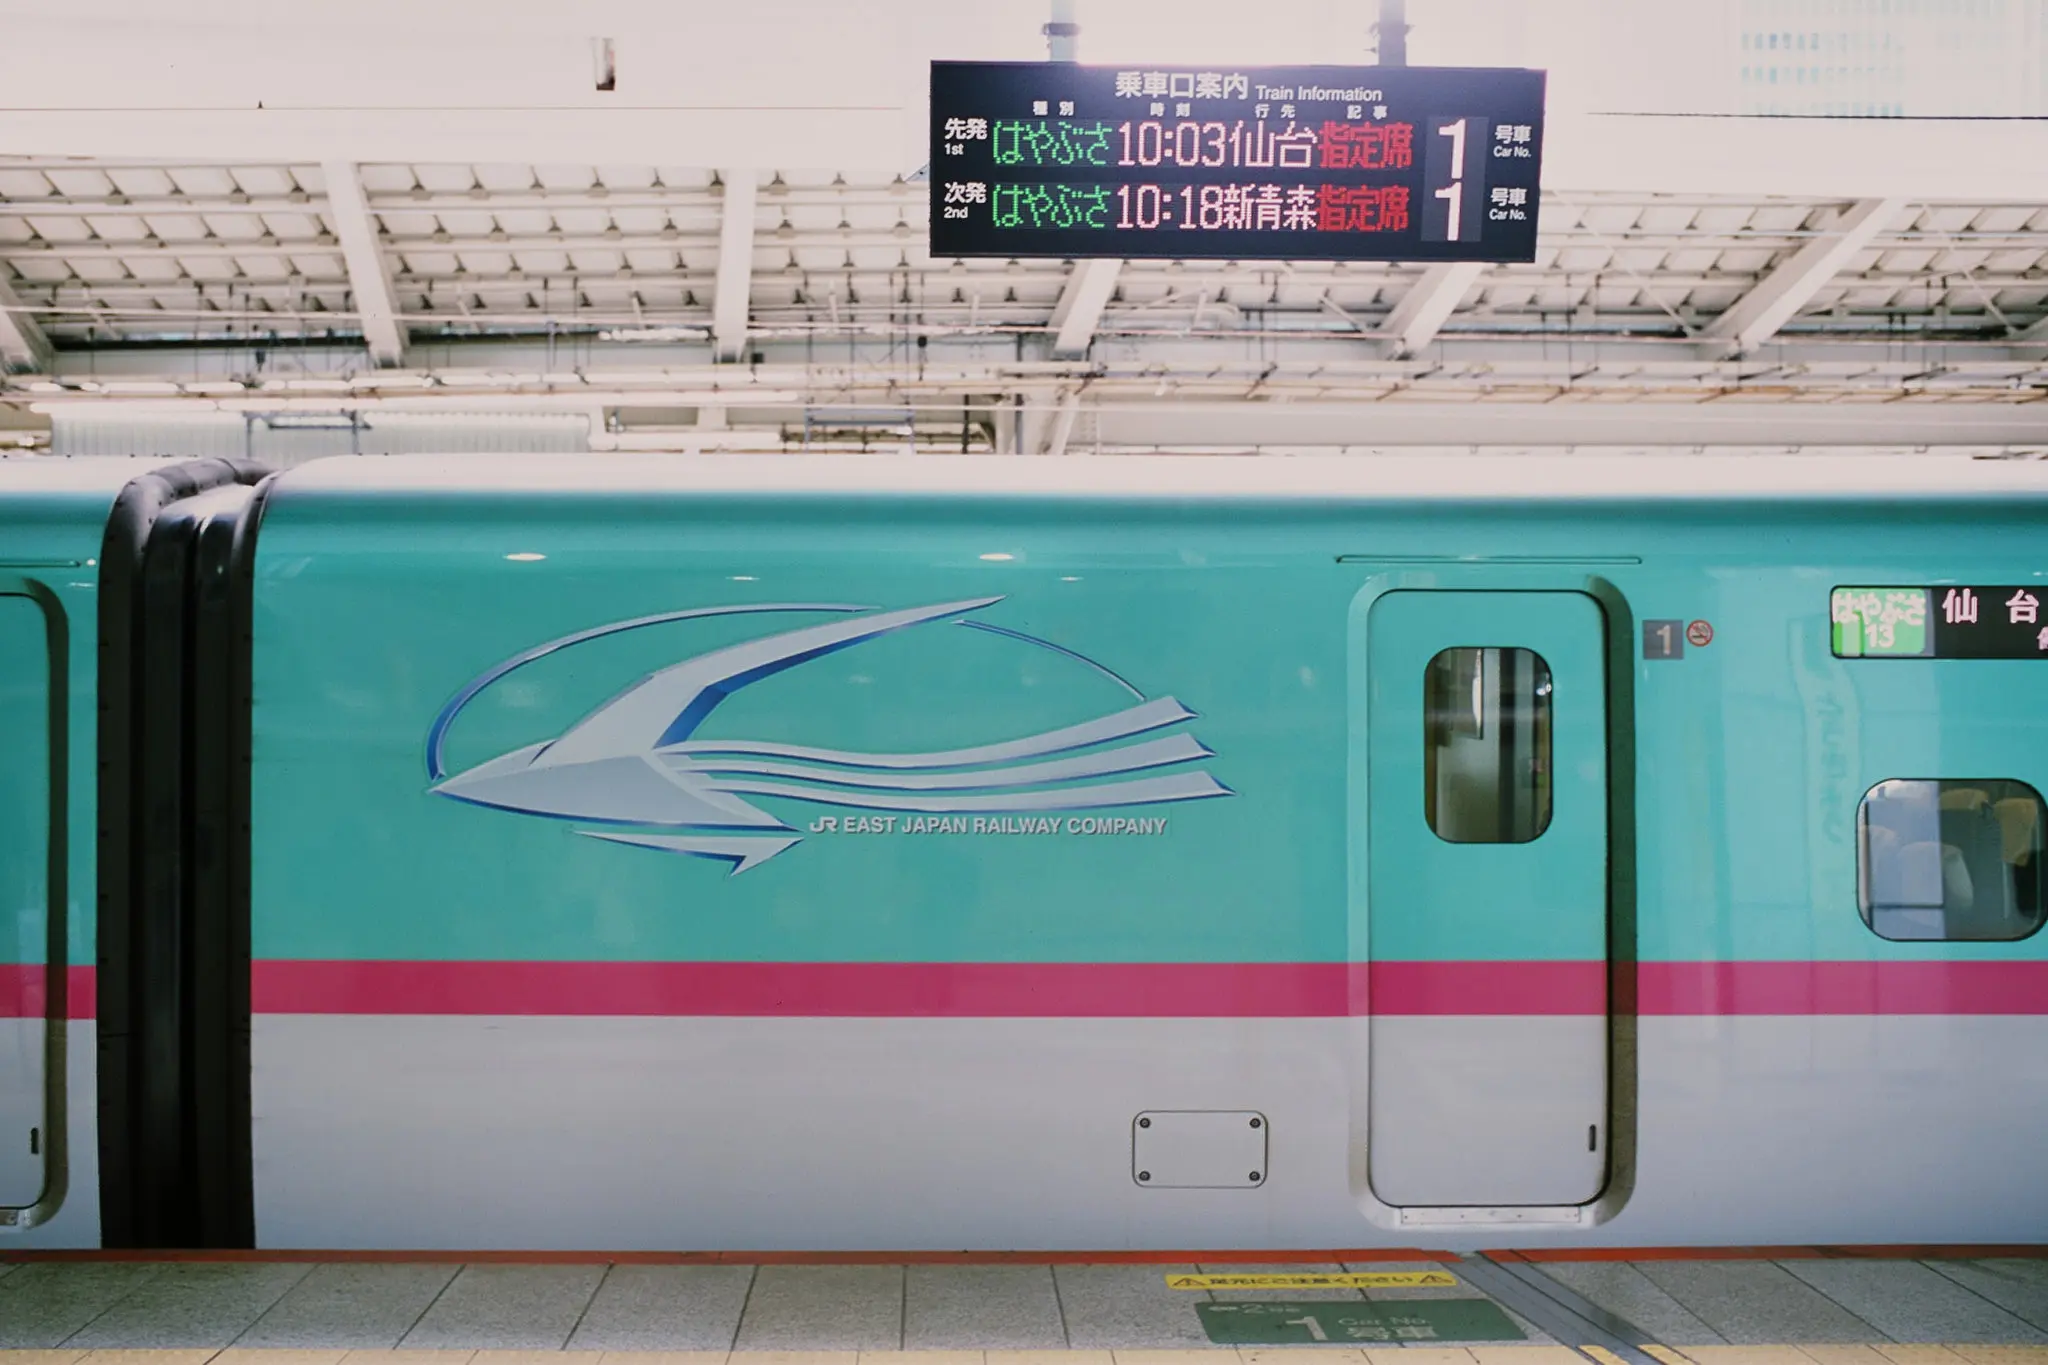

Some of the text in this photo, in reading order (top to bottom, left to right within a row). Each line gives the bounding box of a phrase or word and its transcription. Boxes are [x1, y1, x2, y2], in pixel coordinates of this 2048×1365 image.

[1115, 71, 1249, 100] 乗車口案内
[1255, 85, 1382, 101] Train Information
[1033, 100, 1074, 116] 種別
[1255, 104, 1296, 119] 行先
[944, 118, 987, 140] 先発
[1494, 125, 1531, 144] 号車
[945, 144, 964, 155] 1st
[993, 120, 1413, 169] はやぶさ 10:03 仙台 指定席
[1438, 118, 1466, 179] 1
[1493, 146, 1531, 158] Car No.
[944, 182, 986, 204] 次発
[1490, 188, 1527, 207] 号車
[944, 207, 968, 219] 2nd
[992, 183, 1410, 232] はやぶさ 10:18 新青森 指定席
[1435, 182, 1463, 241] 1
[1489, 208, 1527, 221] Car No.
[1832, 592, 1926, 625] はやぶさ
[1656, 624, 1671, 655] 1
[1865, 624, 1895, 648] 13
[809, 817, 1166, 835] JR EAST JAPAN RAILWAY COMPANY
[1285, 1316, 1329, 1341] 1
